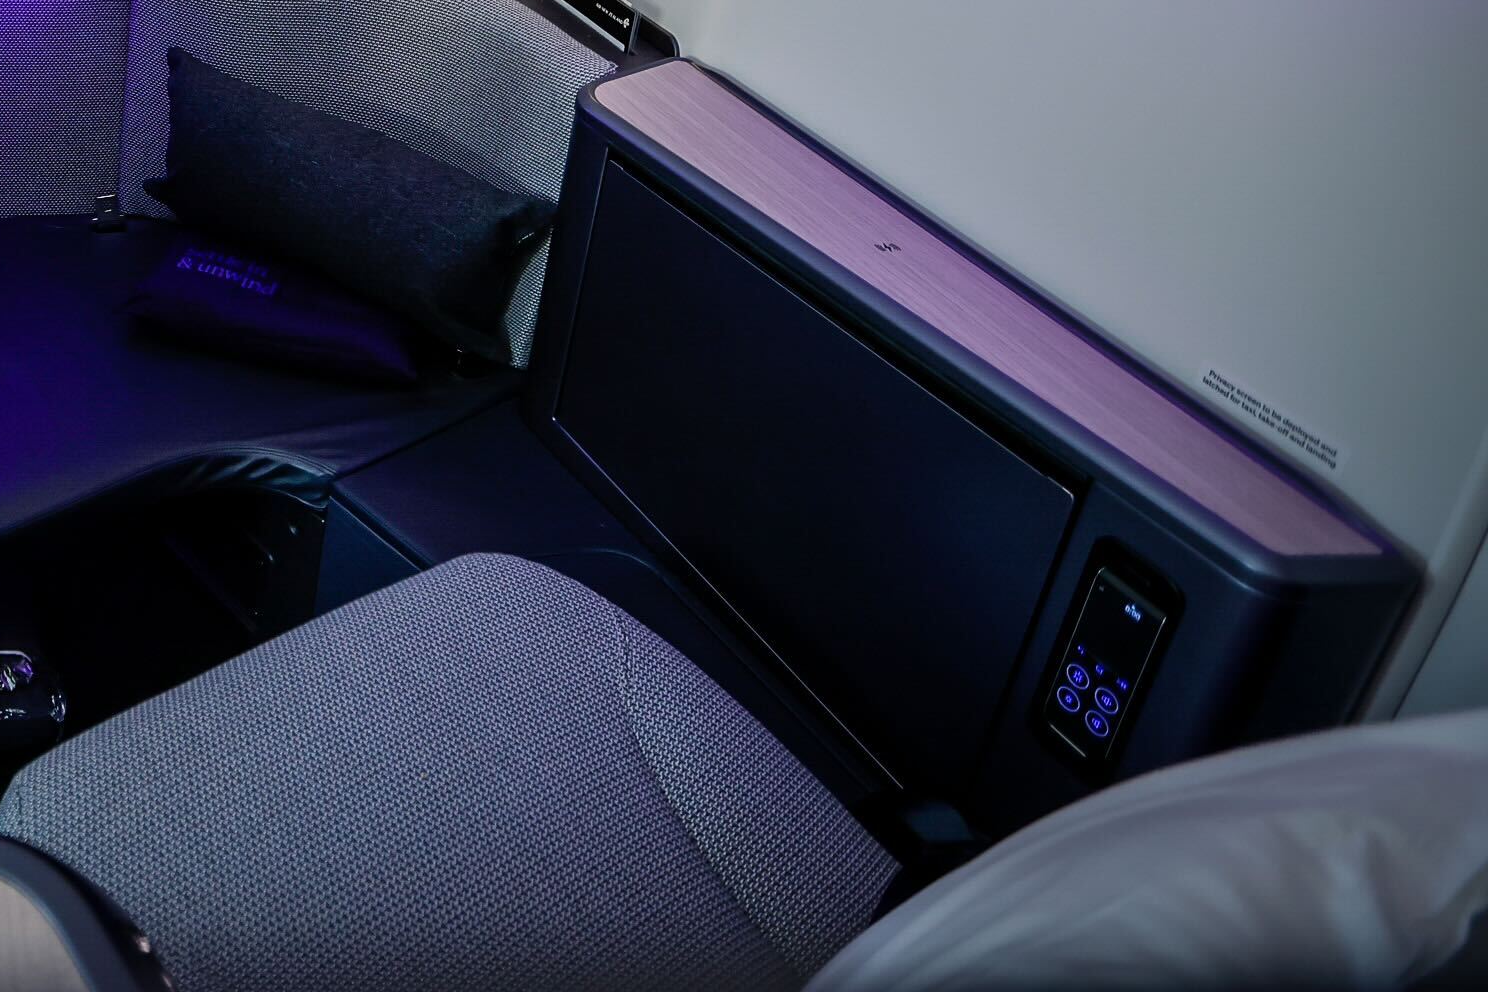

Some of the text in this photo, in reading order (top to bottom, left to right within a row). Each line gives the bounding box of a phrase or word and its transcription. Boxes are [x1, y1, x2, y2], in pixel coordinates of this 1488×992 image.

[176, 255, 279, 296] & unwind
[1202, 376, 1230, 398] latched
[1230, 393, 1241, 405] for
[1258, 412, 1289, 437] take-off
[1289, 434, 1306, 448] and
[1306, 443, 1337, 470] landing
[1208, 369, 1337, 457] Privacy screen to be deployed and
